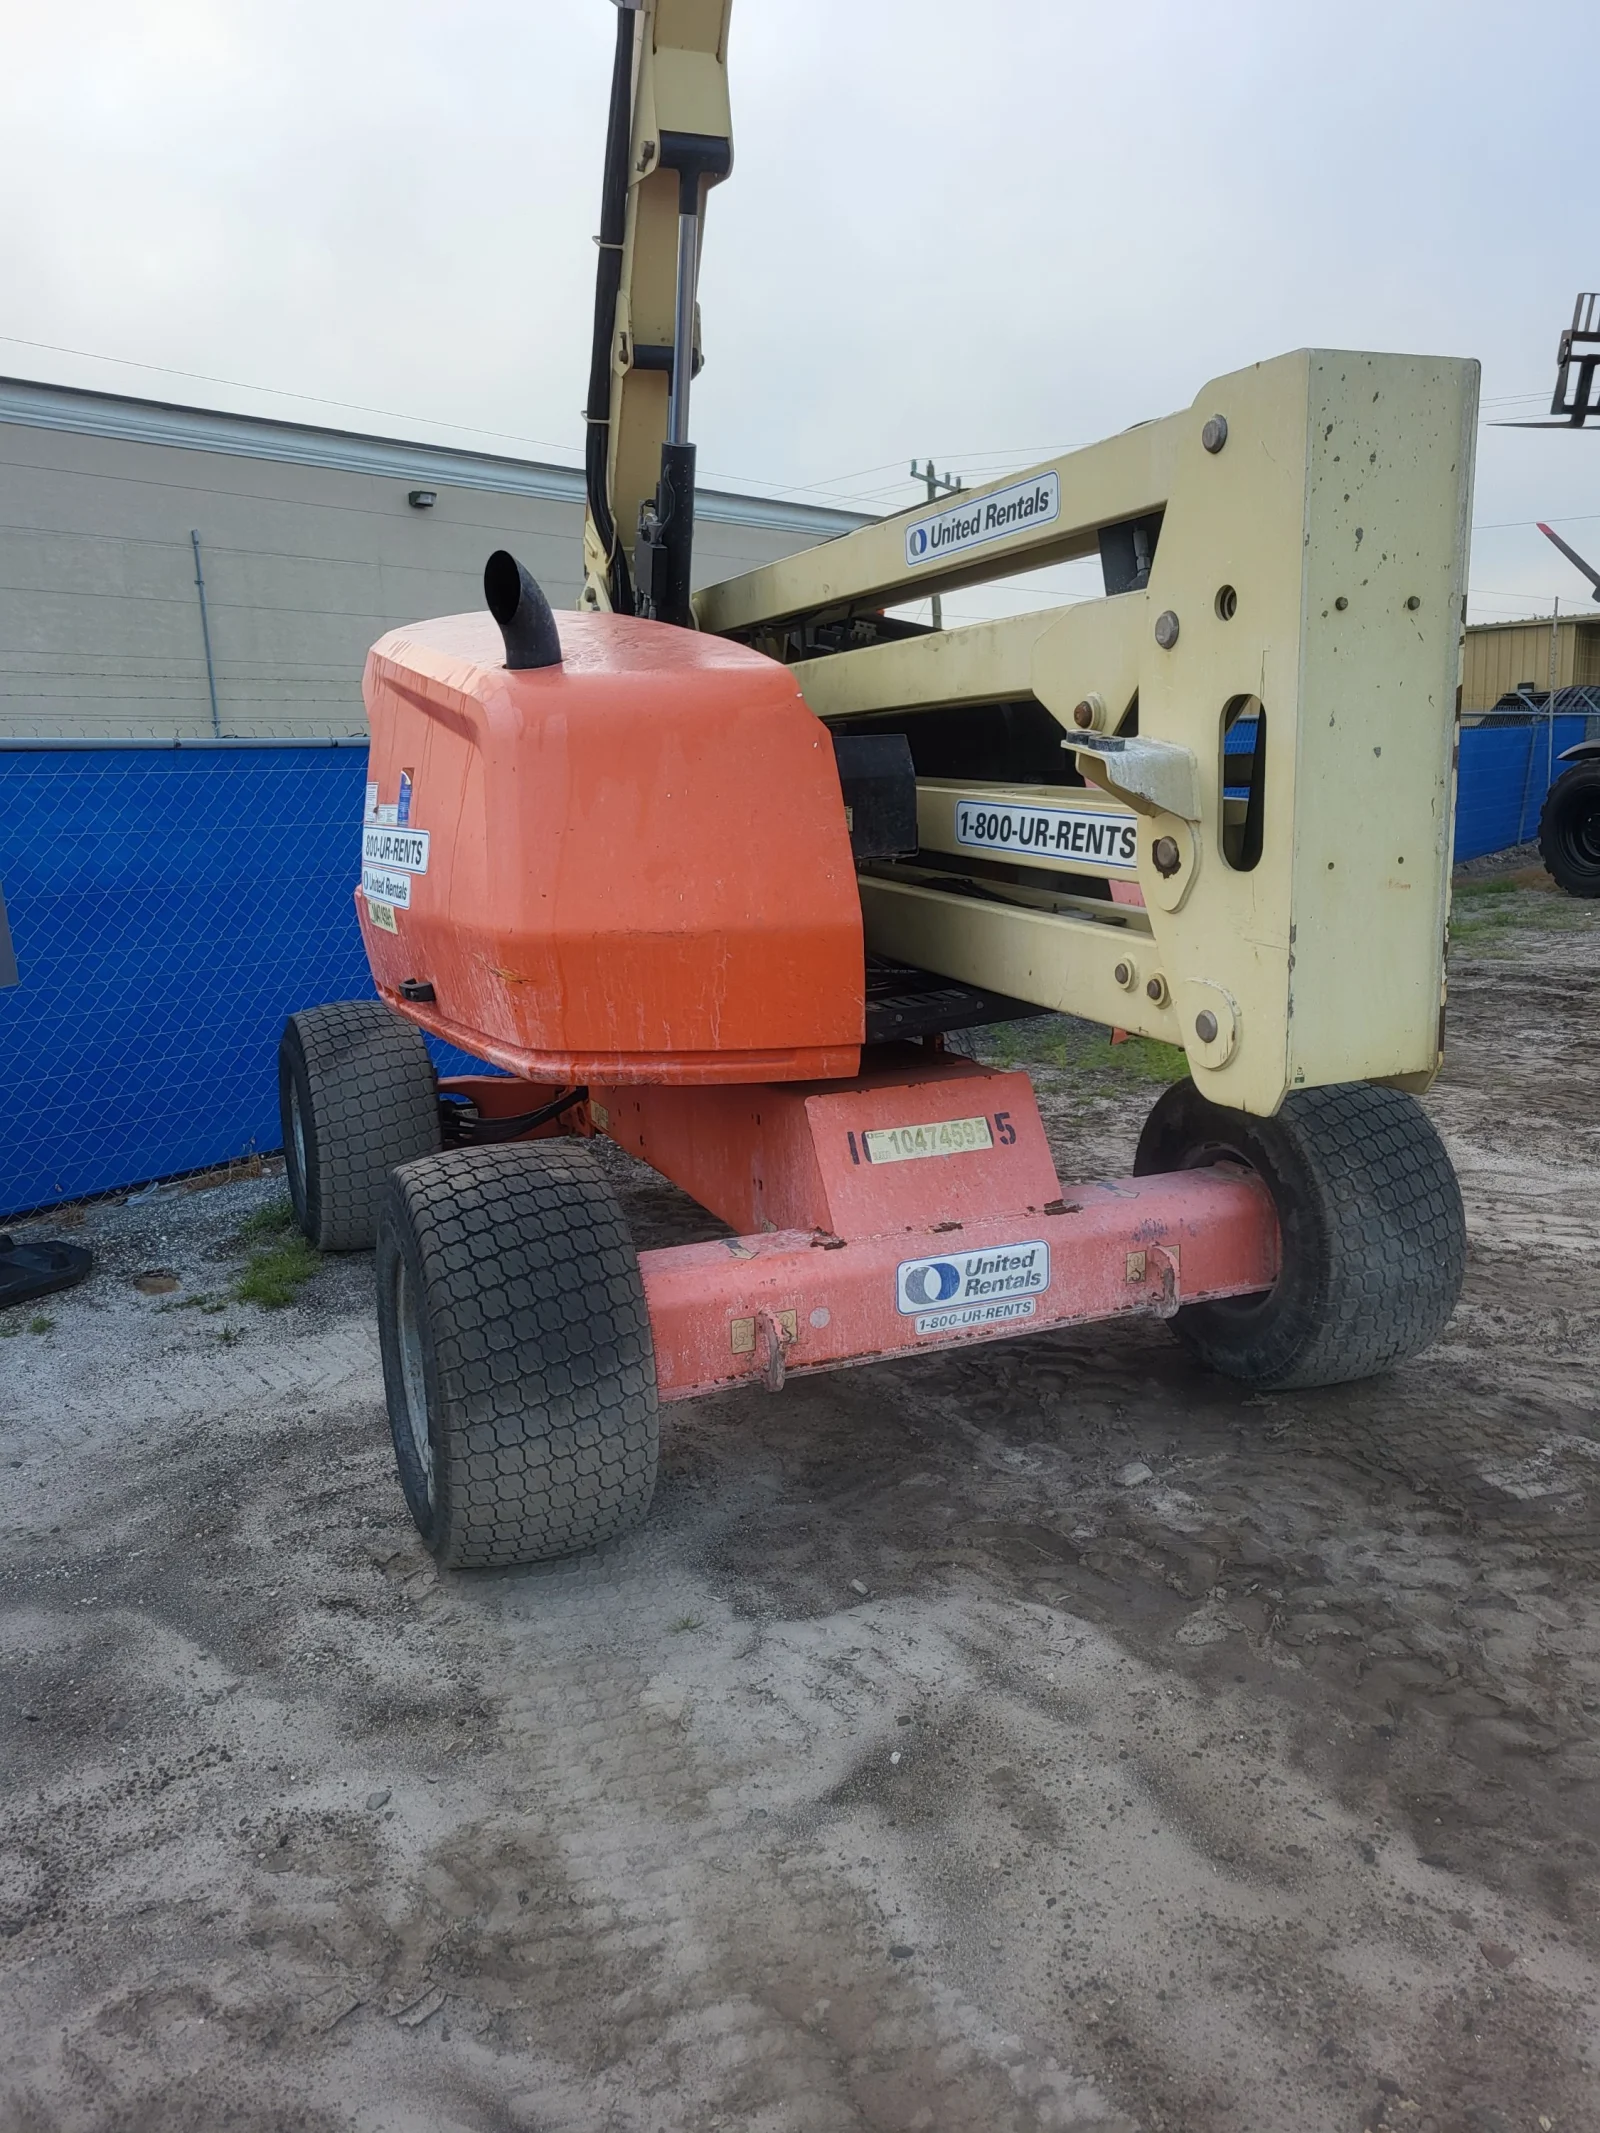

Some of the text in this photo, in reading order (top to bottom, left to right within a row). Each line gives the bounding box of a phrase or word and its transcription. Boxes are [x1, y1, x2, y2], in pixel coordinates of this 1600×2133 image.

[930, 486, 1050, 549] United Rentals
[960, 811, 1137, 859] 1-800-UR-RENTS
[368, 872, 408, 901] United Rentals
[888, 1119, 989, 1155] 10474595
[965, 1249, 1036, 1277] United
[964, 1270, 1042, 1297] Rentals
[919, 1301, 1032, 1330] 1-800-UR-RENTS
